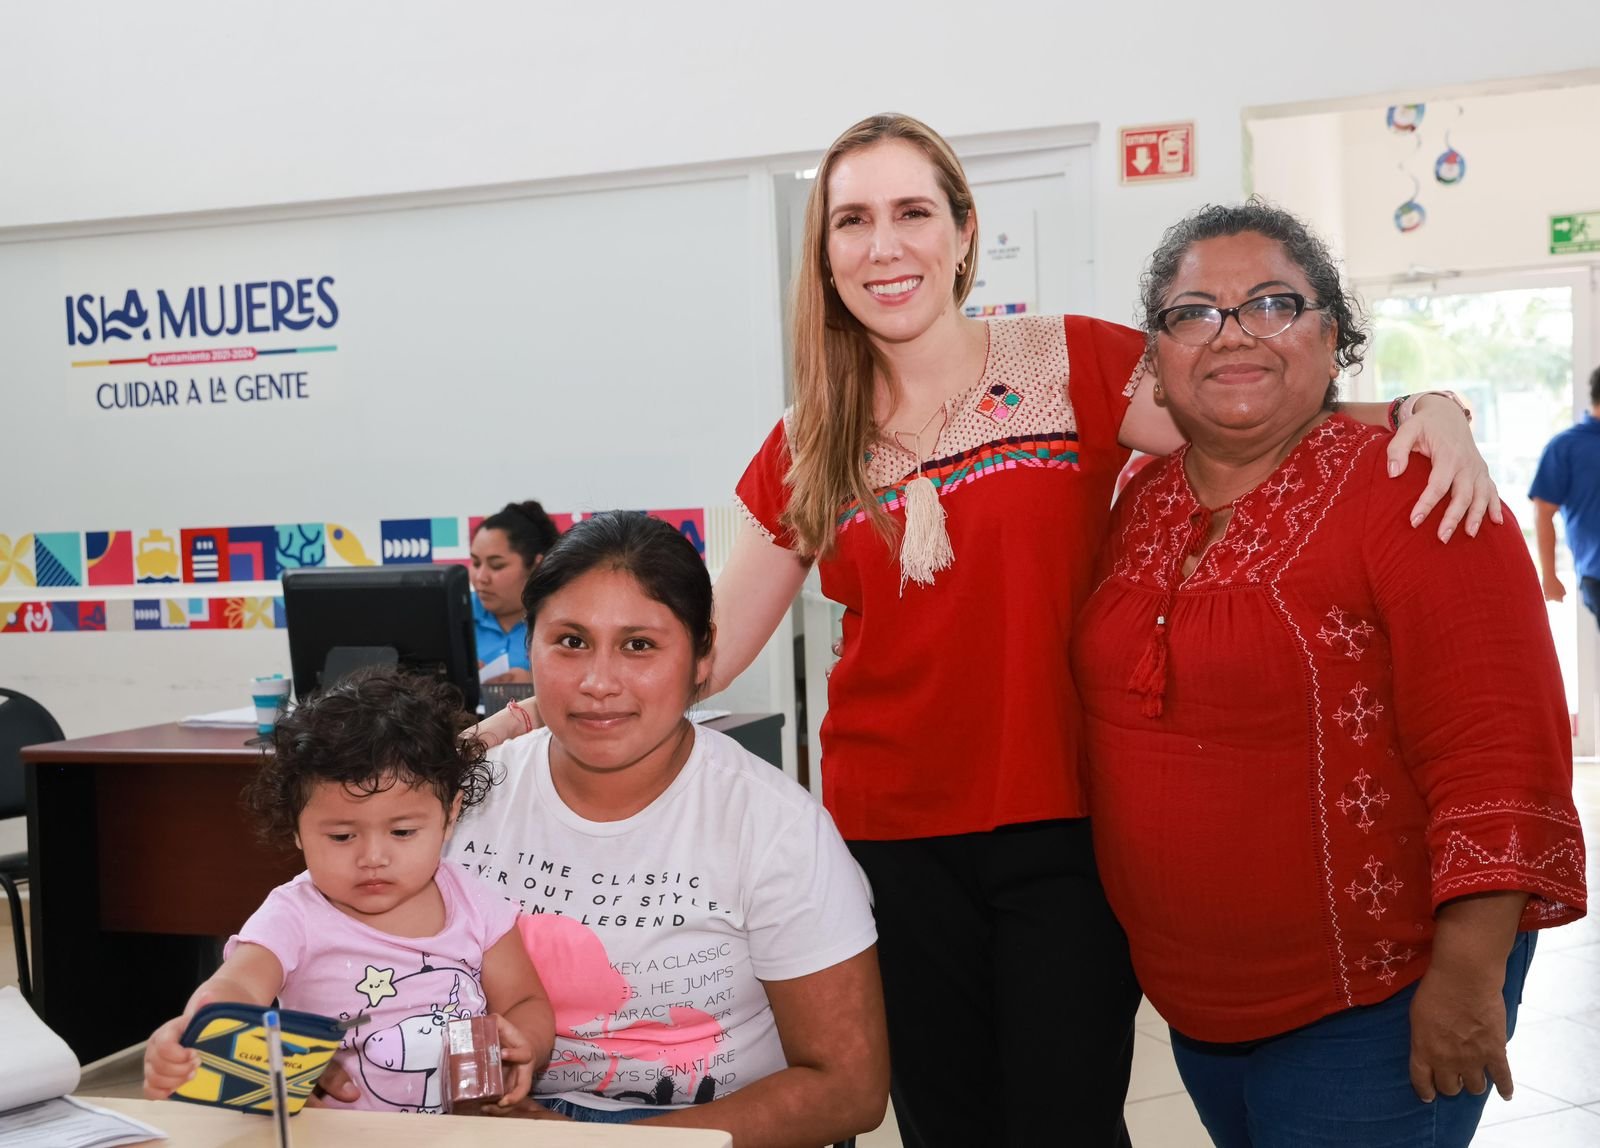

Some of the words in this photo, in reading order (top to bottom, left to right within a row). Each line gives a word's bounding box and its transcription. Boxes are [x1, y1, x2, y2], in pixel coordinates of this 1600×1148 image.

[65, 288, 152, 346] ISLA
[157, 275, 339, 340] MUJERES
[97, 379, 178, 410] CUIDAR
[186, 379, 201, 405] A
[210, 376, 227, 403] LA
[235, 371, 309, 401] GENTE
[464, 840, 497, 855] AL
[518, 852, 572, 878] TIME
[591, 872, 700, 889] CLASSIC
[523, 877, 574, 901] OUT
[592, 894, 623, 906] OF
[581, 914, 685, 928] LEGEND
[646, 959, 659, 973] A
[662, 942, 731, 970] CLASSIC
[651, 980, 675, 995] HE
[681, 965, 734, 995] JUMPS
[704, 986, 735, 1008] ART.
[239, 1052, 262, 1062] CLUB
[563, 1070, 640, 1083] MICKY'S
